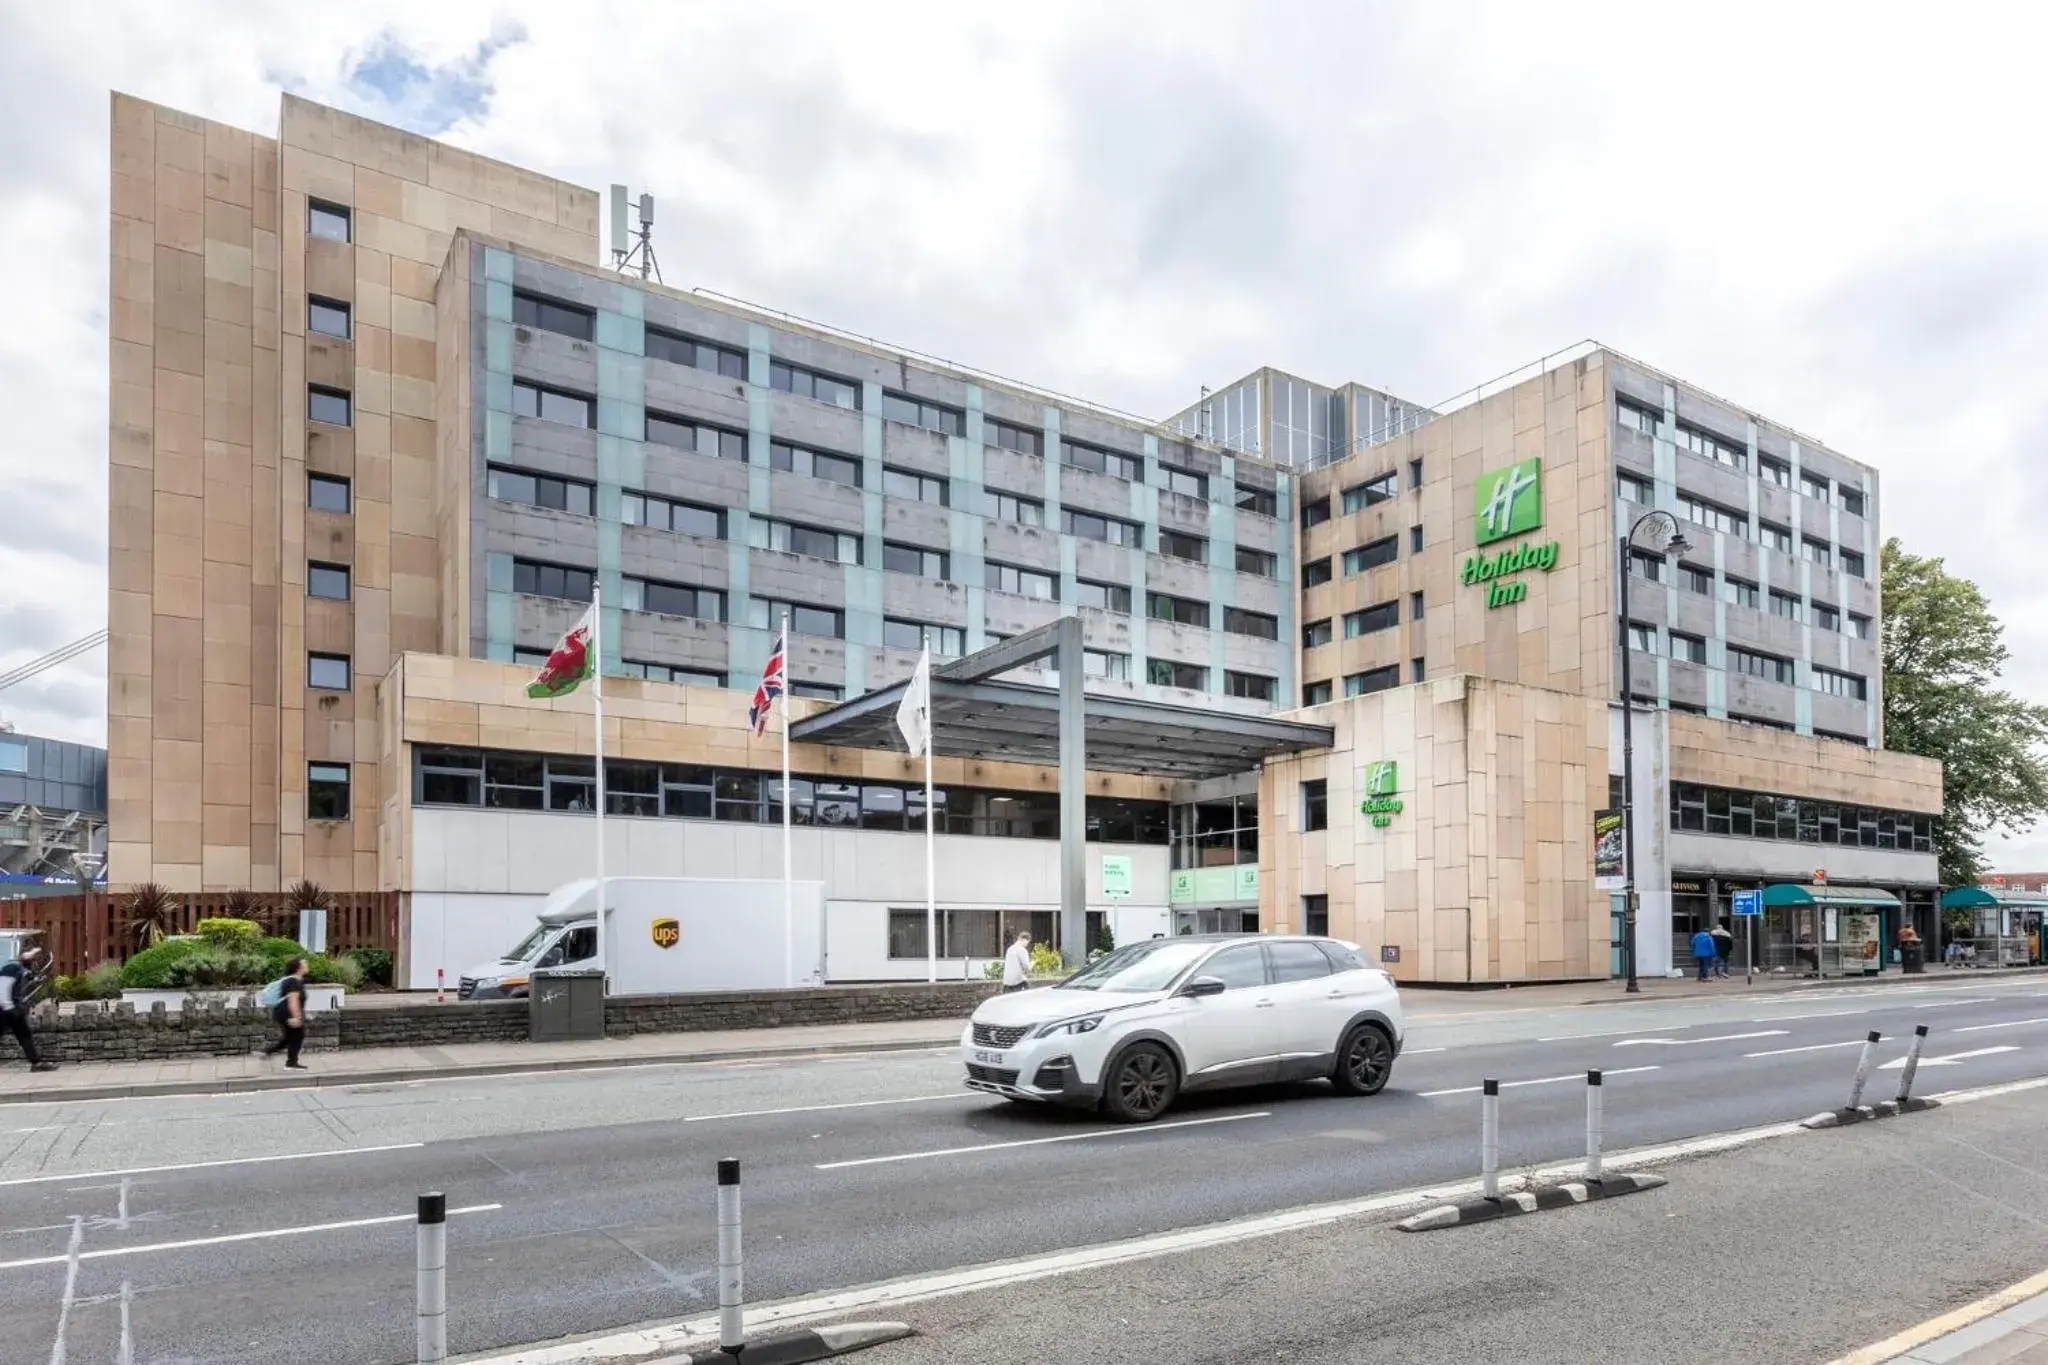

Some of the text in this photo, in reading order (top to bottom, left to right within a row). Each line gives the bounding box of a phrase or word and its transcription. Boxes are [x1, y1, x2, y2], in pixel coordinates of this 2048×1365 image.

[1461, 541, 1559, 586] Holiday
[1488, 580, 1527, 610] Inn
[1362, 799, 1404, 815] Holiday
[654, 927, 678, 946] ups
